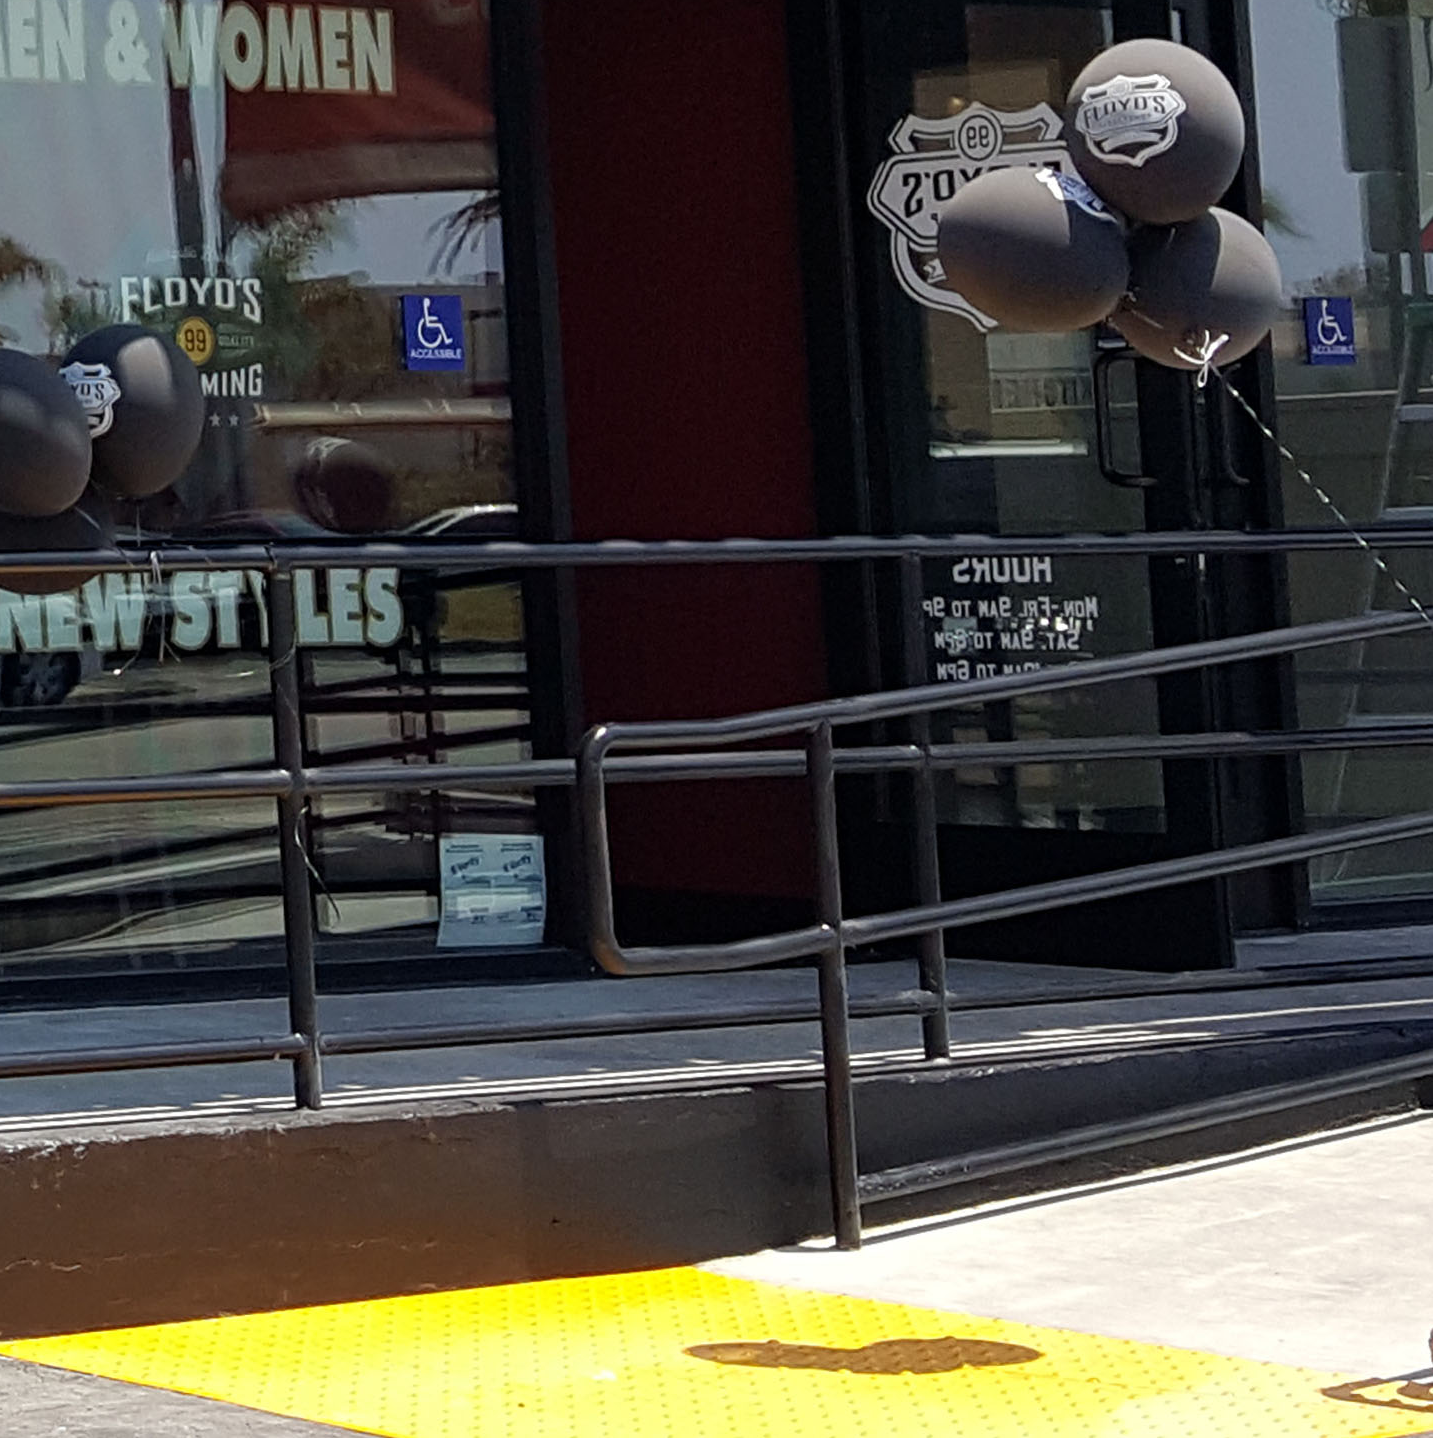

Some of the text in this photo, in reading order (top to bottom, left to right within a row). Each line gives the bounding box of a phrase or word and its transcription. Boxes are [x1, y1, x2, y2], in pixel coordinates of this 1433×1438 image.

[160, 0, 398, 96] WOMEN
[1084, 94, 1167, 130] FLOYD'S
[120, 275, 263, 325] FLOYD'S
[184, 328, 207, 353] 99
